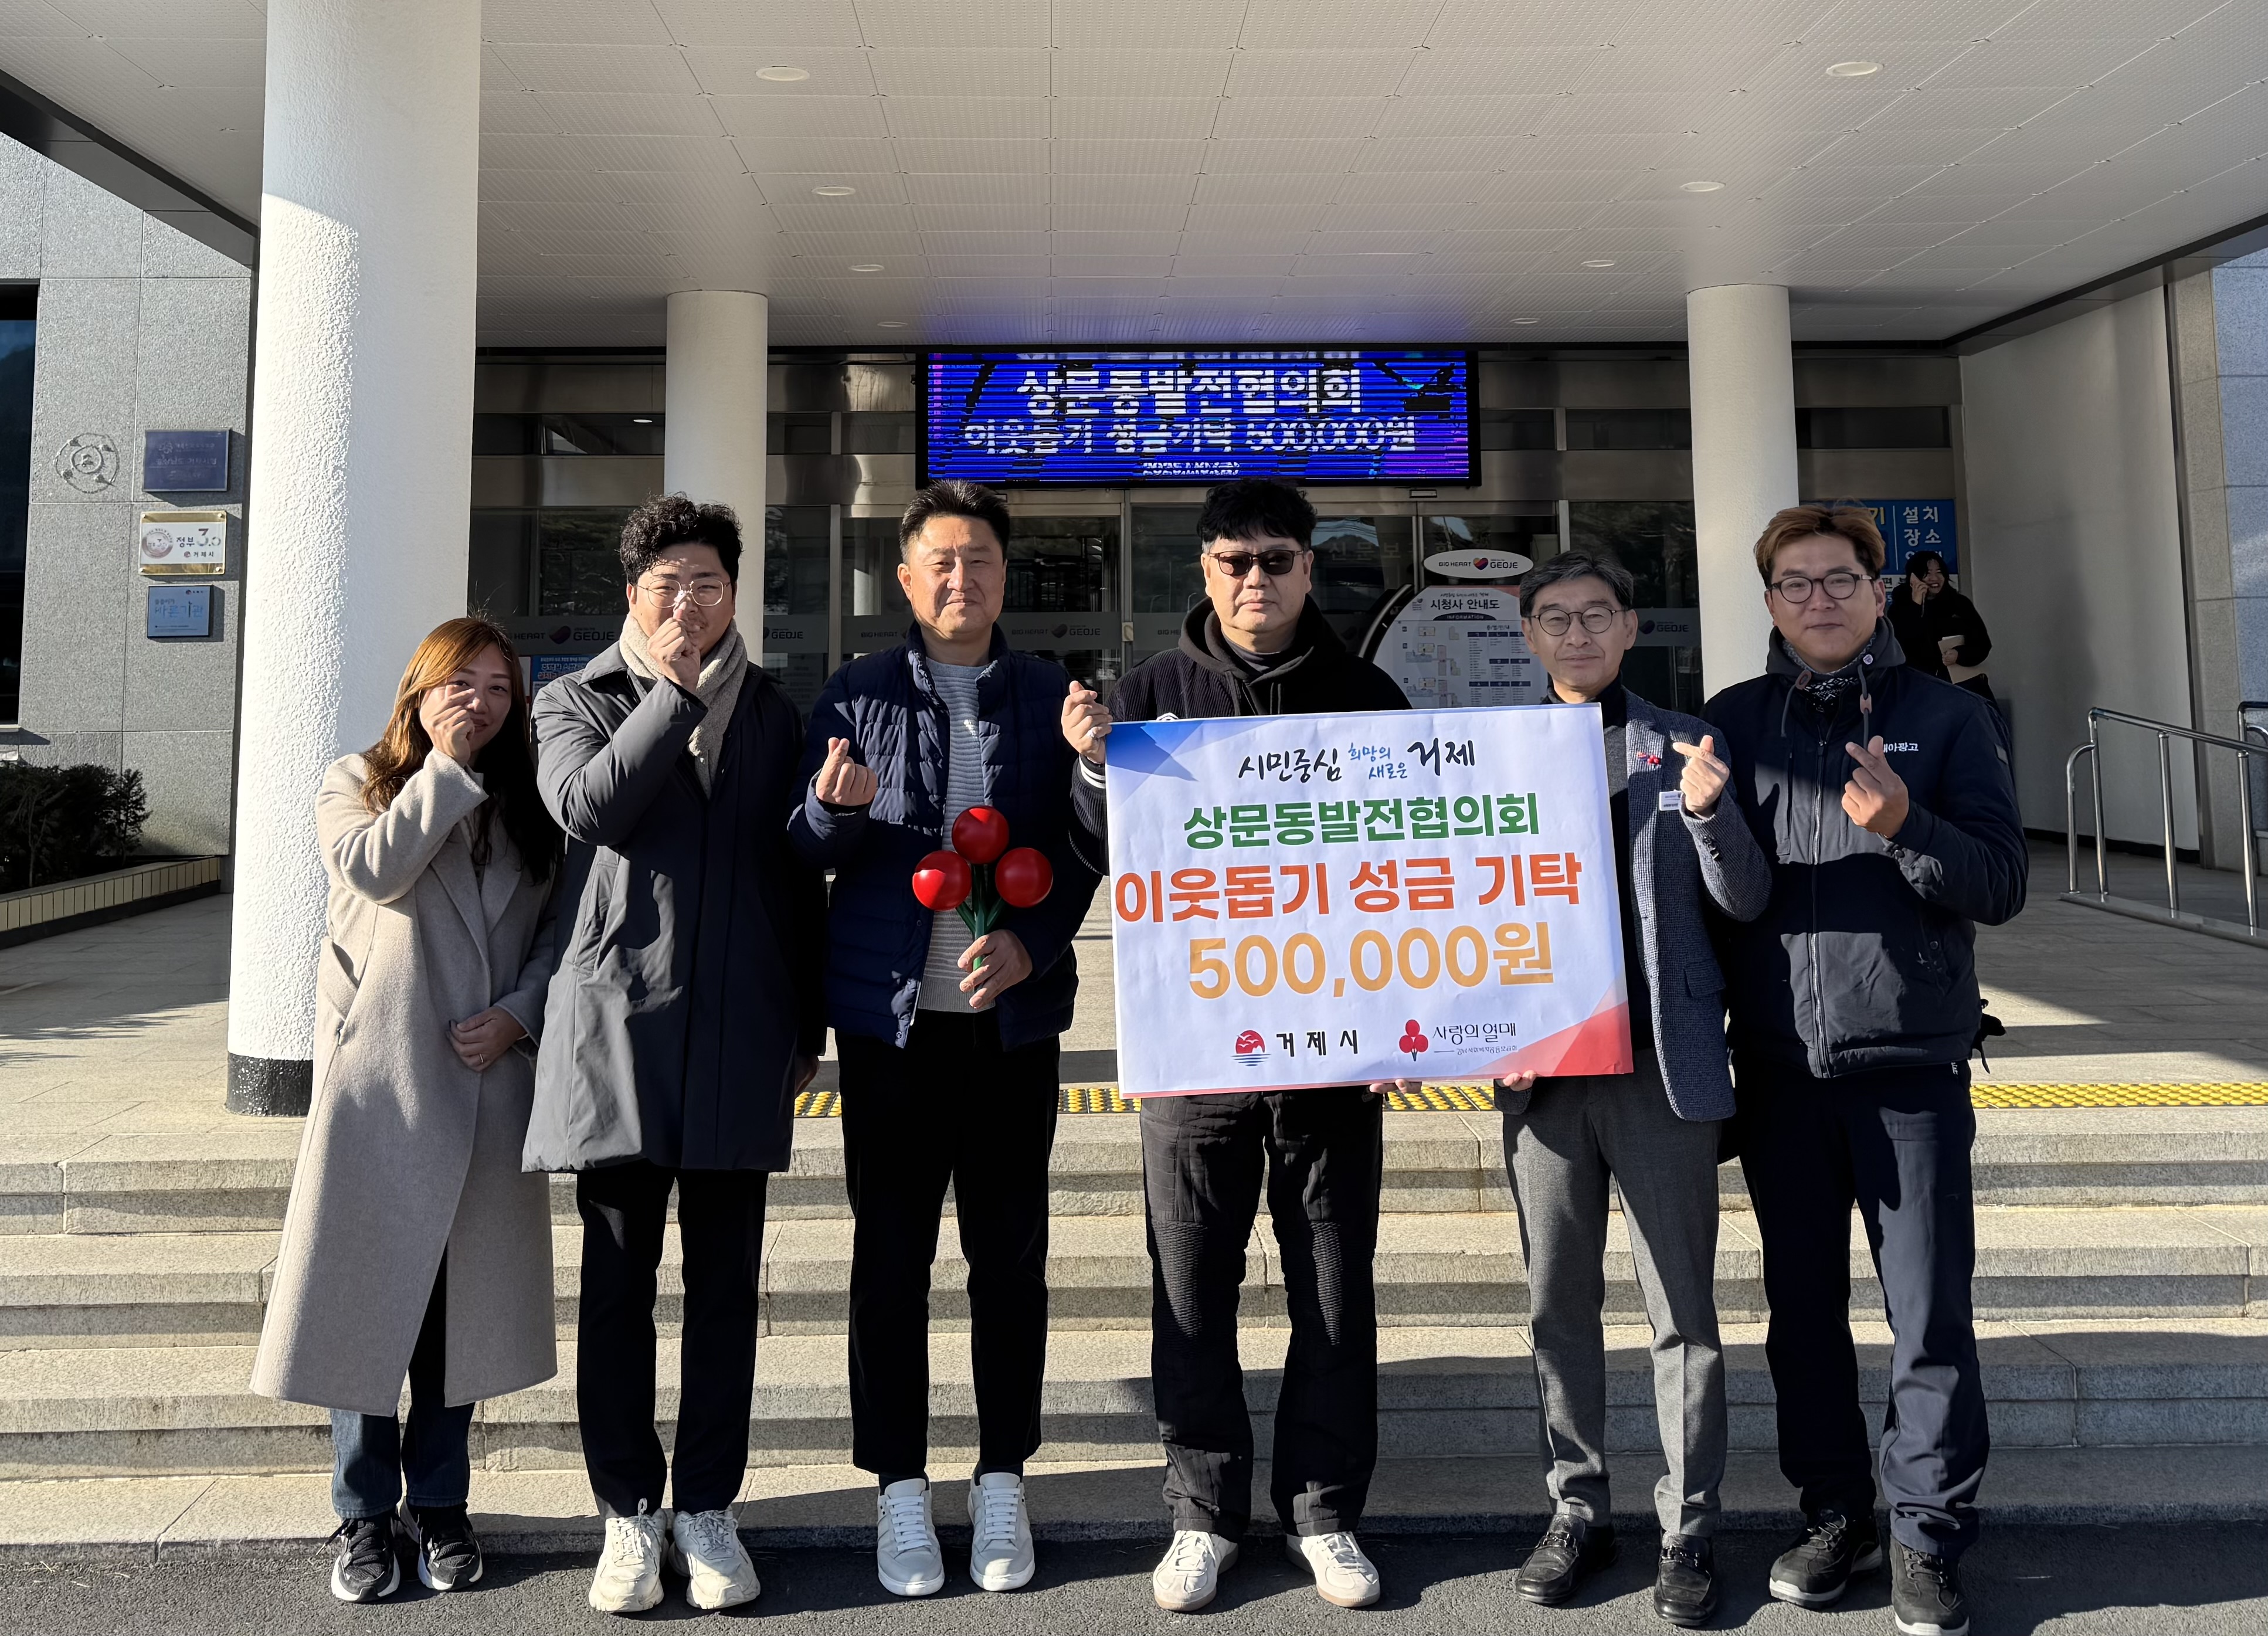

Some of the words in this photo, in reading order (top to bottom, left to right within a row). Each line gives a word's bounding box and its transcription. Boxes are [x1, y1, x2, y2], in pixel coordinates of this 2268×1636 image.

[1017, 371, 1361, 415] 상문동발전협의회
[1903, 506, 1938, 524] 설치
[176, 537, 195, 548] 정부
[197, 528, 221, 547] 3.0
[1904, 529, 1941, 547] 장소
[1431, 598, 1464, 610] 시청사
[1467, 598, 1500, 610] 안내도
[573, 632, 615, 640] GEOJE
[1348, 742, 1391, 762] 희망의
[1407, 737, 1475, 776] 거제
[1238, 748, 1343, 783] 시민중심
[1368, 762, 1408, 780] 새로운
[1184, 792, 1540, 850] 상문동발전협의회
[1115, 862, 1330, 923] 이웃돕기
[1349, 857, 1455, 913] 성금
[1475, 852, 1583, 907] 기탁
[1189, 921, 1554, 999] 500,000원
[1276, 1029, 1359, 1057] 거제시
